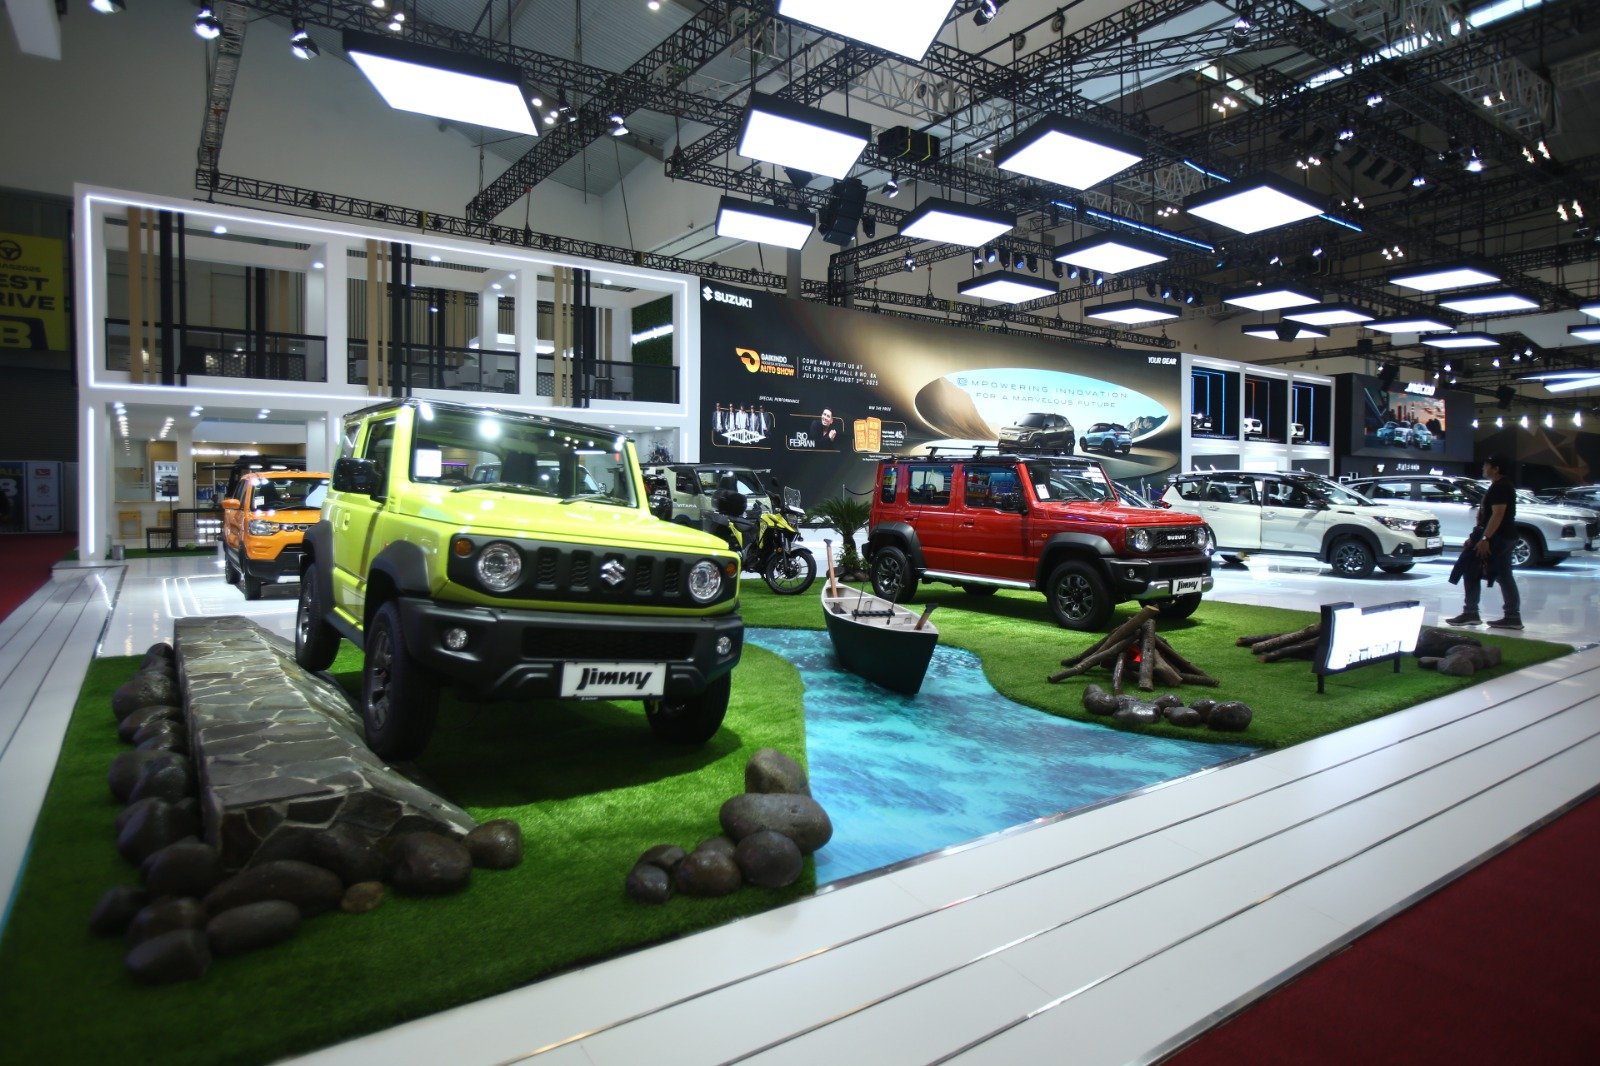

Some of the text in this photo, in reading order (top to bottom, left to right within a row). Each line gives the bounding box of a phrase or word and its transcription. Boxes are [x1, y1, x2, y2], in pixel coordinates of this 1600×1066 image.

[714, 291, 753, 308] SUZUKI
[760, 354, 788, 364] GAIKINDO
[1162, 357, 1177, 365] GEAR
[760, 364, 795, 376] AUTO SHOW
[834, 375, 854, 383] AUGUST
[1056, 387, 1128, 398] INNOVATION
[1012, 395, 1074, 406] MARVELOUS
[1176, 580, 1198, 592] Jimny
[576, 668, 653, 690] Jimny
